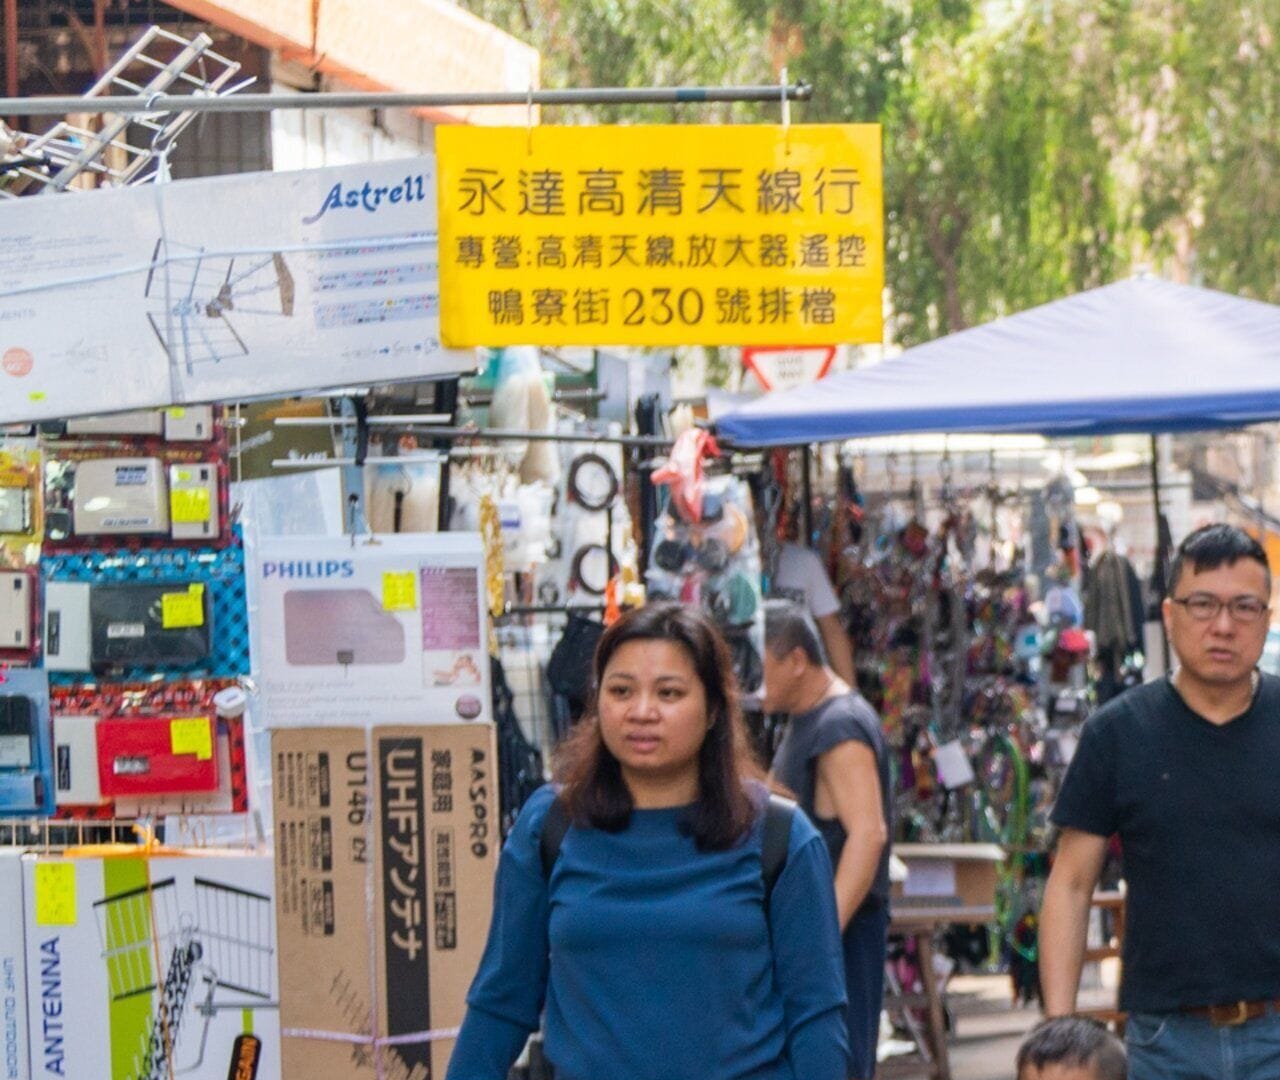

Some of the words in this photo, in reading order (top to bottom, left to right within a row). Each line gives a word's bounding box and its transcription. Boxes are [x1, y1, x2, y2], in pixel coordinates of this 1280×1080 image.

[302, 175, 426, 224] Astrell
[457, 166, 862, 217] 永達高清天線行
[262, 560, 355, 579] PHILIPS
[386, 748, 421, 961] UHFアンテナ
[40, 936, 66, 1076] ANTENNA
